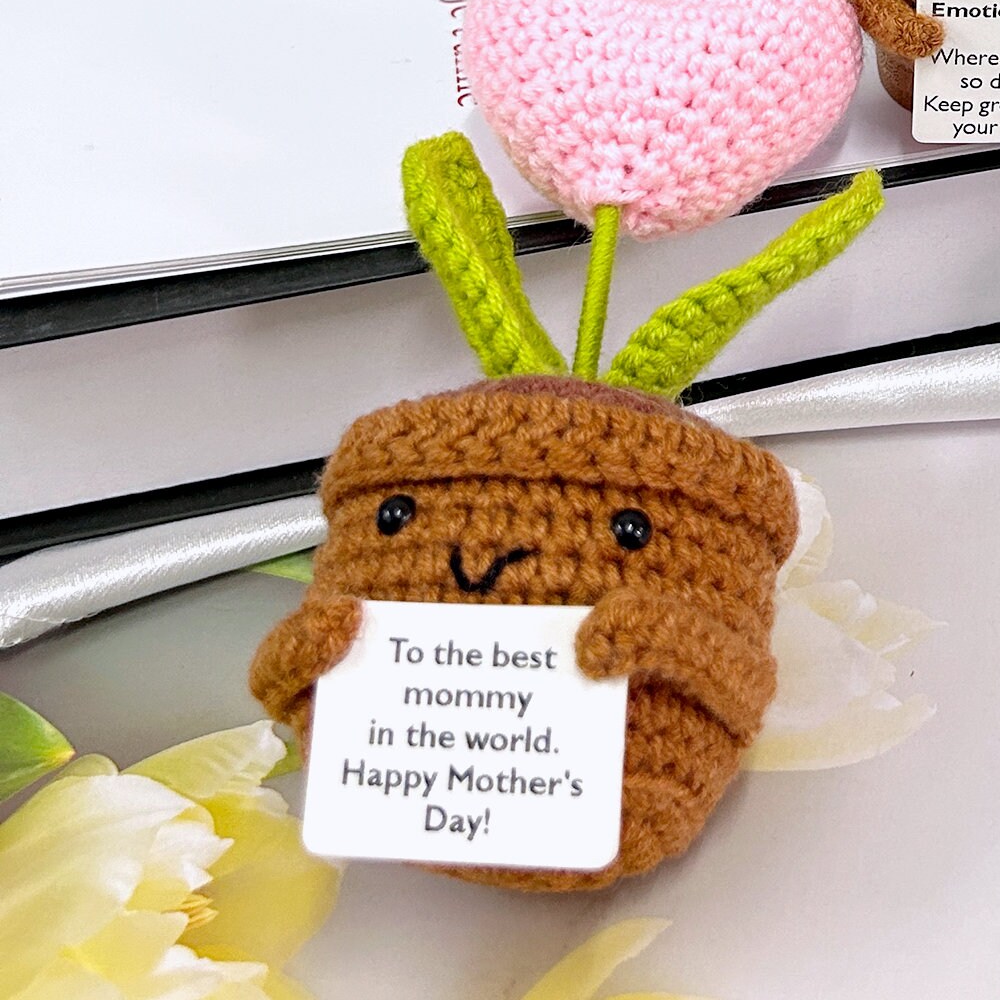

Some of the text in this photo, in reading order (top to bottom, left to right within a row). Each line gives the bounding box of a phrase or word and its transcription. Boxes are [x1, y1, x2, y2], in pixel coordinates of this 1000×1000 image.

[930, 47, 999, 66] Where
[960, 77, 983, 89] so
[924, 95, 974, 116] Keep
[952, 122, 999, 139] your
[388, 636, 558, 670] To the best
[403, 686, 533, 719] mommy
[368, 719, 559, 754] in the world.
[341, 758, 583, 798] Happy Mother's
[424, 804, 491, 842] Day!
